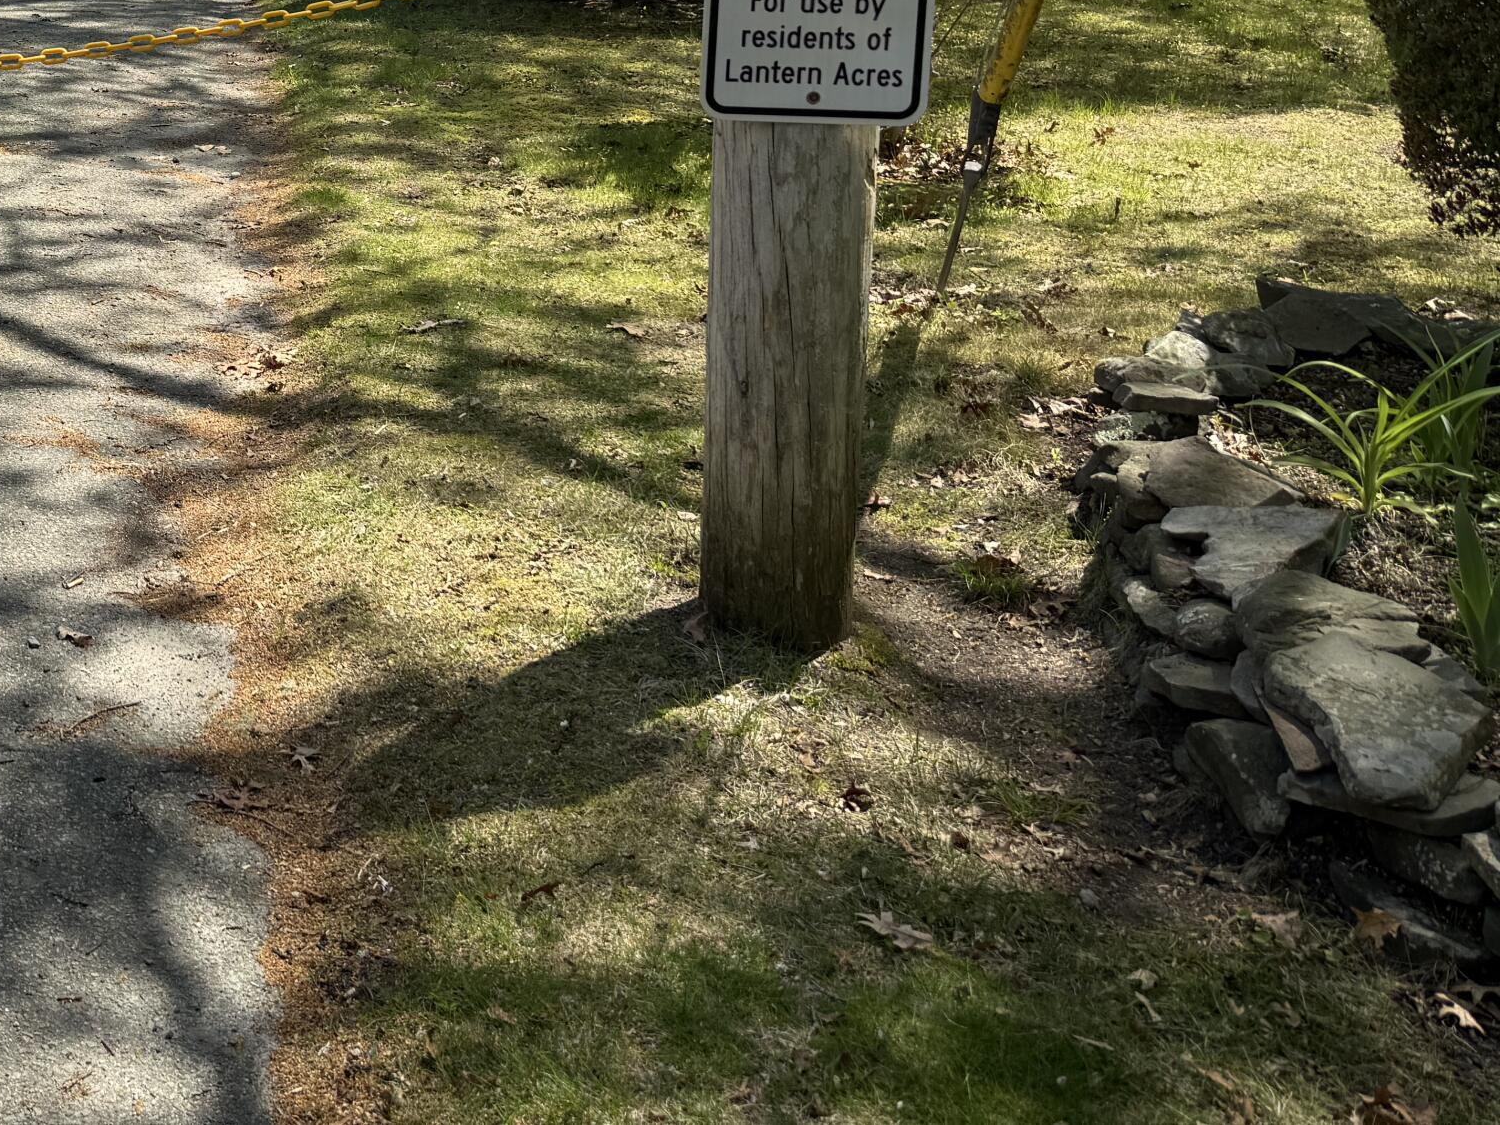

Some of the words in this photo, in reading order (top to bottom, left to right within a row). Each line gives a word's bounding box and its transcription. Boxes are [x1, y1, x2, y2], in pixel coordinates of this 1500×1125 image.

[741, 25, 856, 50] residents
[867, 27, 892, 51] of
[725, 59, 822, 85] Lantern
[833, 62, 903, 87] Acres
